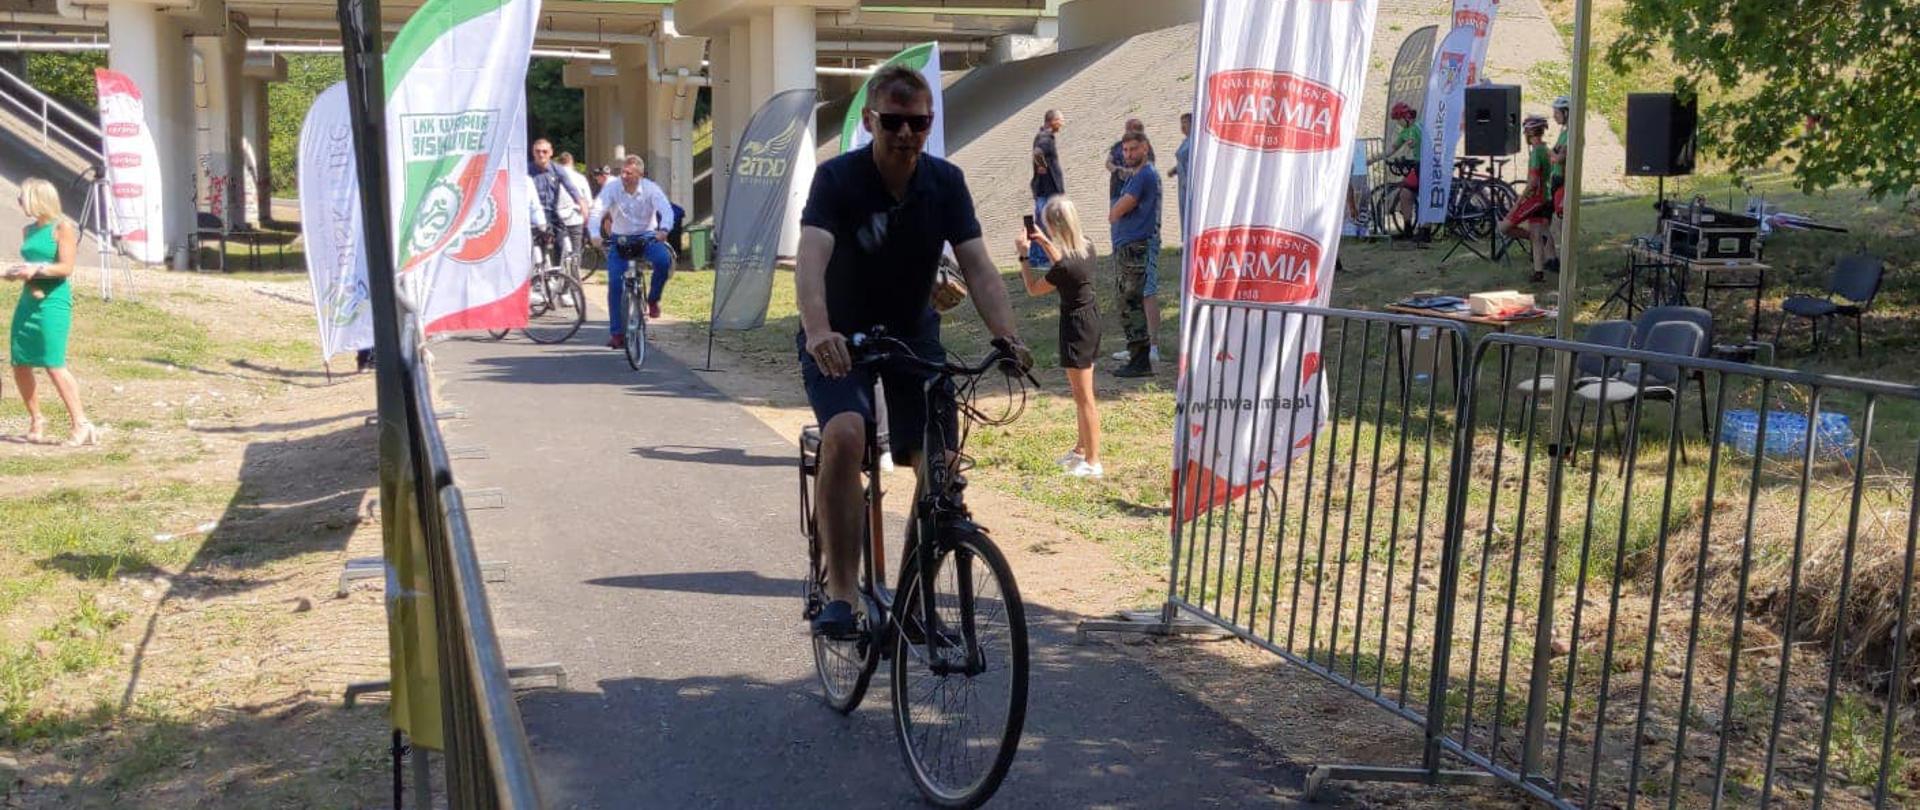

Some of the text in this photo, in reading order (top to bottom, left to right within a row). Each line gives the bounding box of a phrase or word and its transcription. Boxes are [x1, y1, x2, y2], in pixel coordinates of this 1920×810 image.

[413, 118, 435, 134] LKK
[1217, 94, 1332, 135] WARMIA
[1196, 251, 1311, 285] WARMIA
